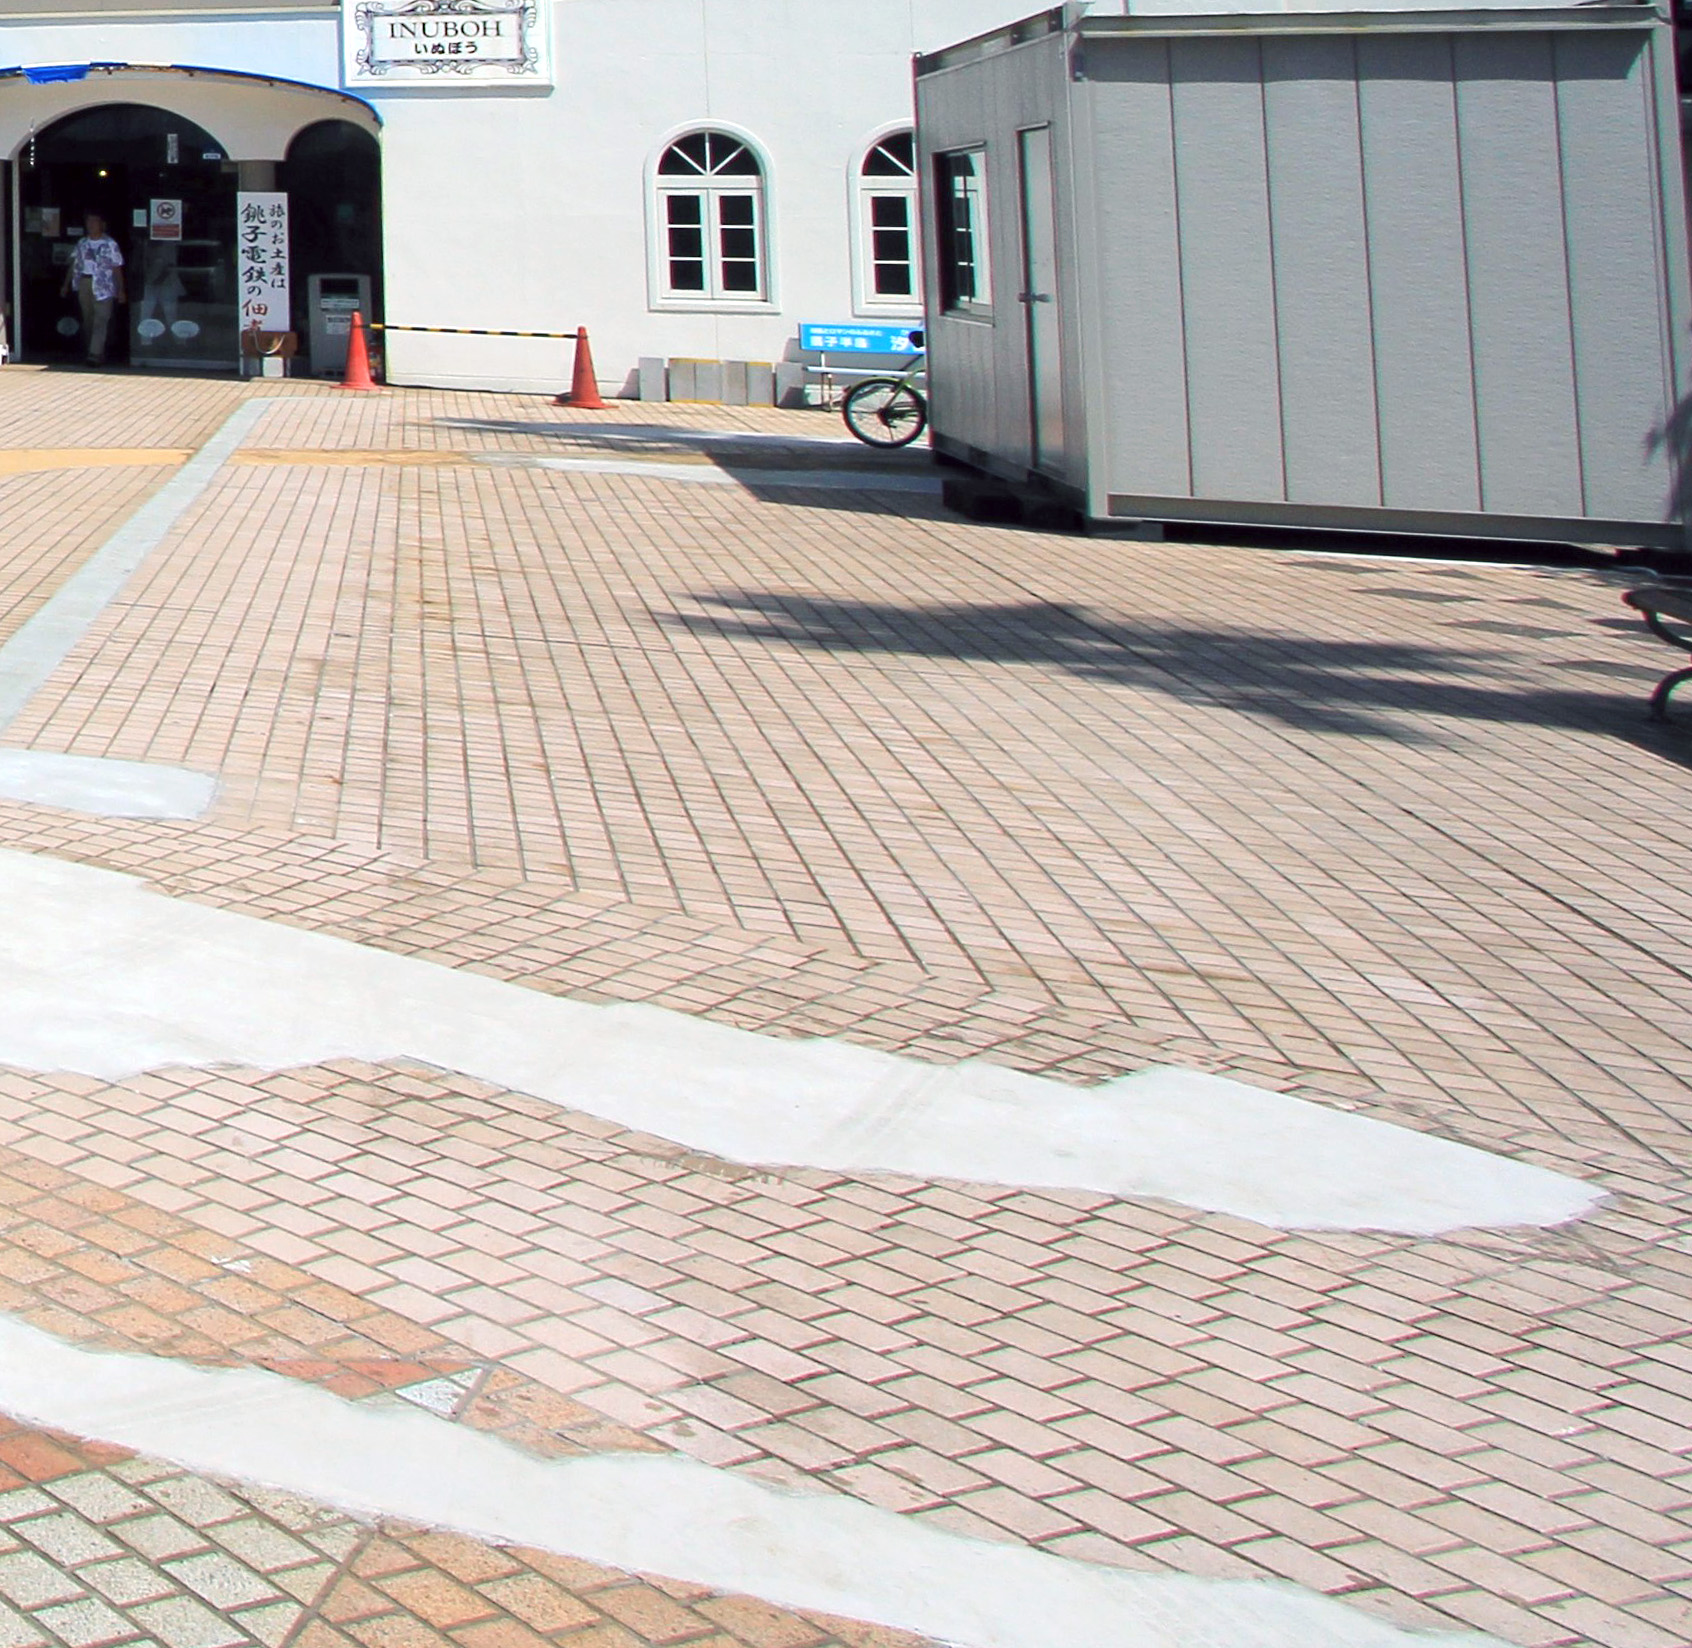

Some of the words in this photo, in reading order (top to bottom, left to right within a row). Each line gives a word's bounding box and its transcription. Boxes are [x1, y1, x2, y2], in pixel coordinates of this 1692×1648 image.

[389, 20, 501, 39] INUBOH
[415, 41, 478, 55] いぬぼう
[269, 204, 286, 290] 旅のお土産は
